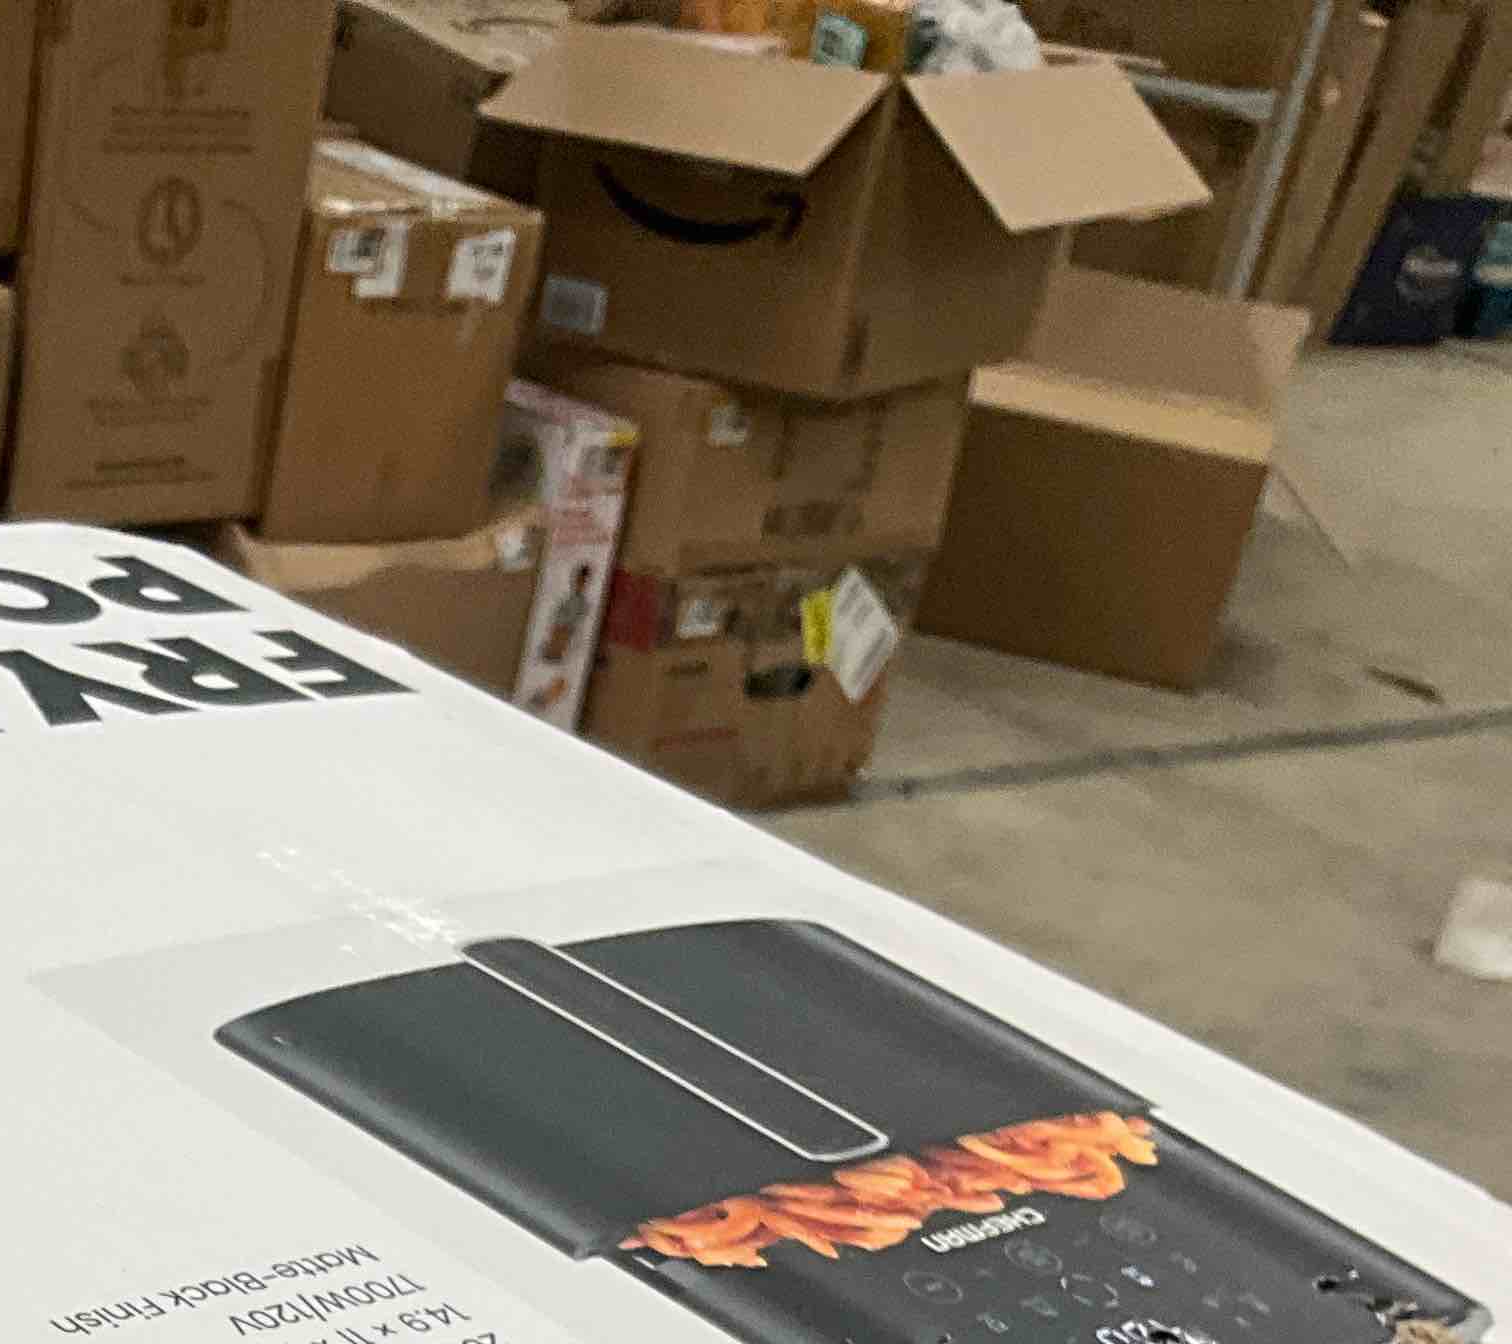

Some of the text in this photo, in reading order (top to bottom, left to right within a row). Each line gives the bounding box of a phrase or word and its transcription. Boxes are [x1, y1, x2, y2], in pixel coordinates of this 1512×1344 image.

[920, 1205, 1046, 1254] CHEFMAN
[49, 1245, 380, 1340] Matte-Black Finish
[228, 1273, 426, 1336] 1700W/120V
